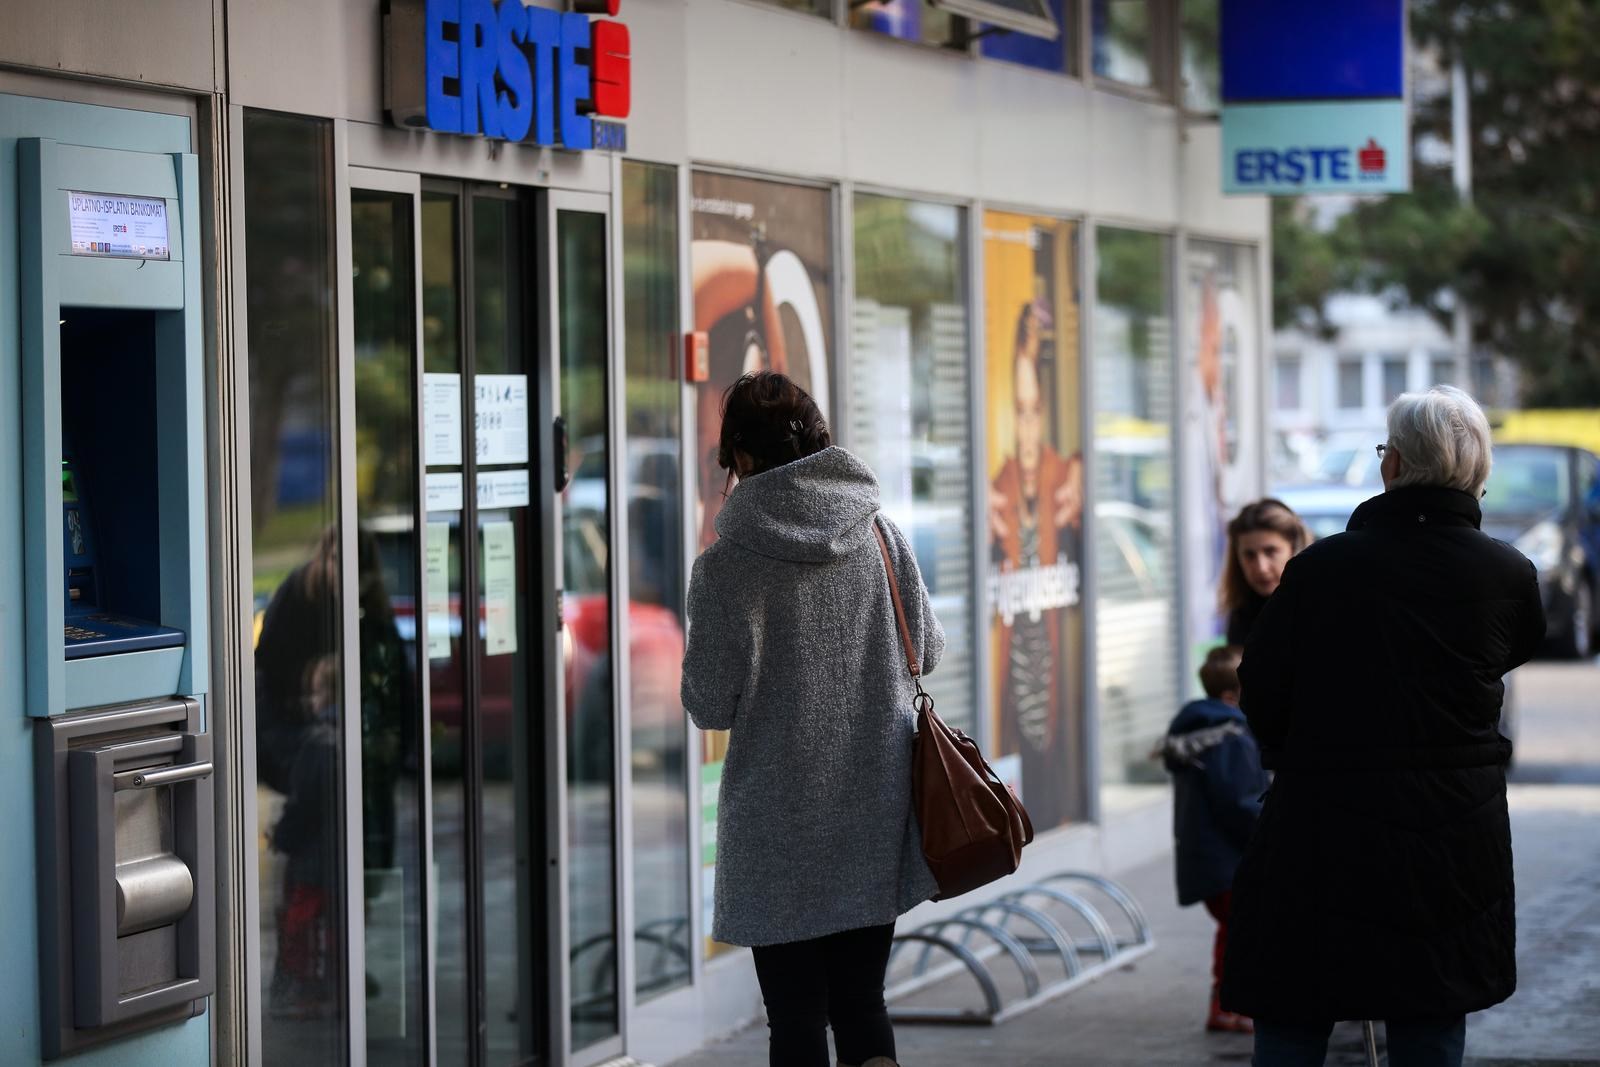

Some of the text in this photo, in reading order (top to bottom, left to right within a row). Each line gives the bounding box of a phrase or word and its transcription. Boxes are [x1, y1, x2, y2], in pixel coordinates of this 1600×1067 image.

[425, 0, 592, 149] ERSTE
[1235, 148, 1350, 184] ERSTE
[72, 198, 162, 217] UPLATNO-ISPLATNI BANKOMAT
